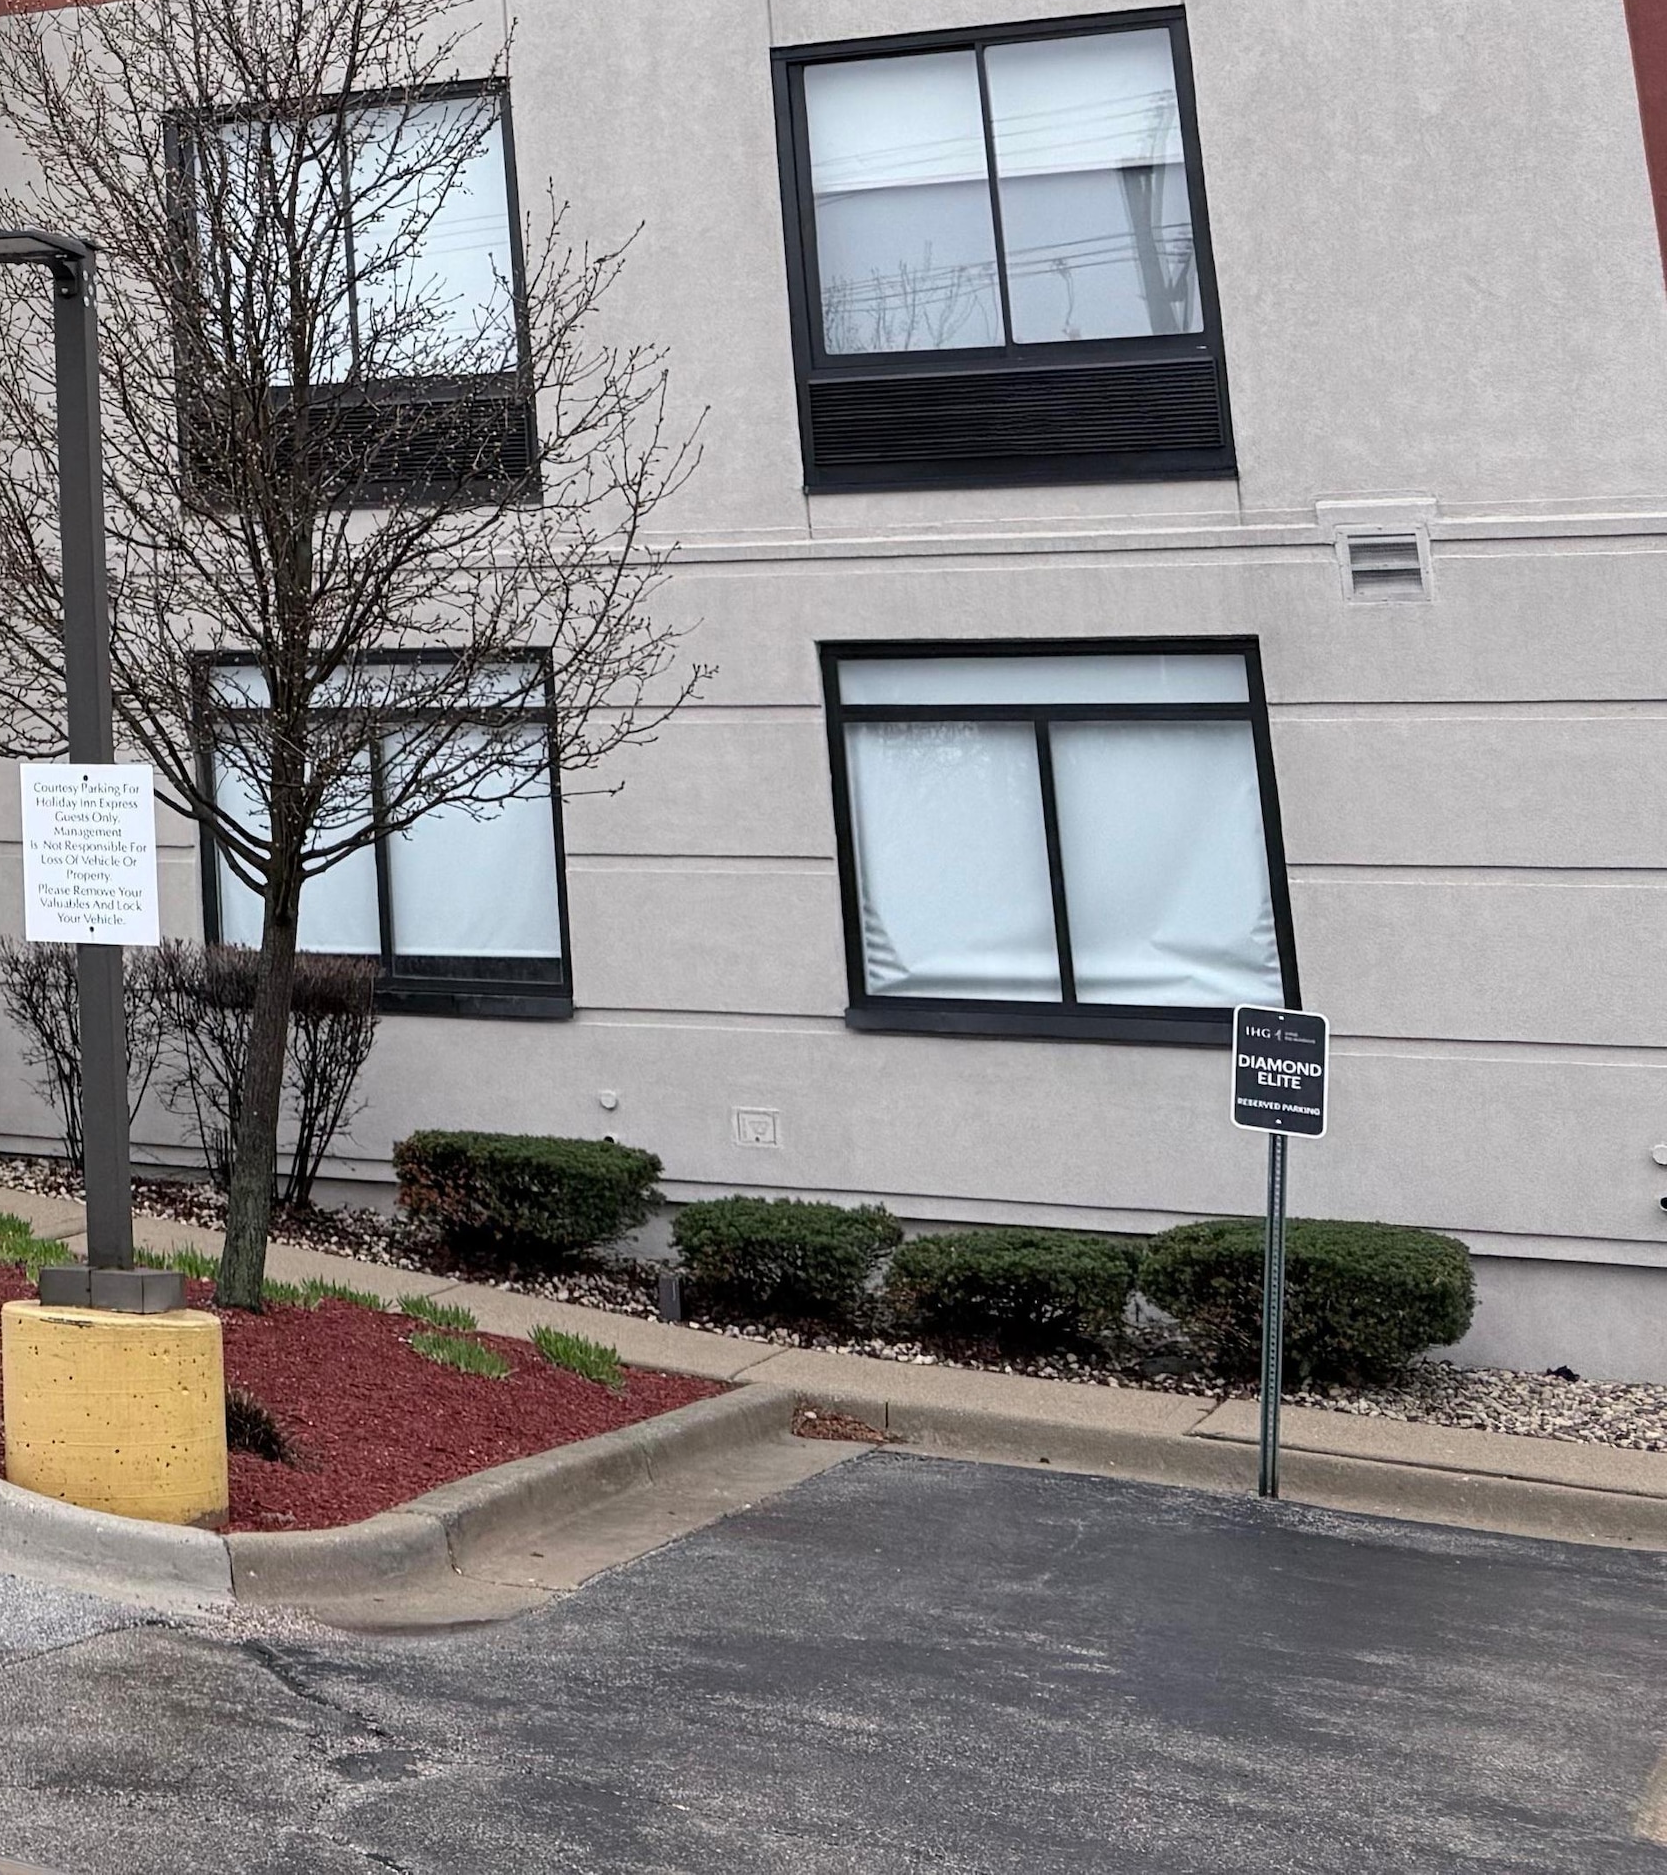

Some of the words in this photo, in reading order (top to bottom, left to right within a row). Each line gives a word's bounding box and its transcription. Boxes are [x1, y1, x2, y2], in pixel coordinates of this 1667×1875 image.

[33, 782, 78, 795] Courtesy
[81, 783, 121, 797] Parking
[123, 783, 140, 794] For
[36, 797, 77, 810] Holiday
[80, 798, 97, 808] Inn
[99, 798, 138, 810] Express
[54, 811, 89, 822] Guests
[92, 812, 121, 825] Only.
[54, 827, 122, 840] Management
[30, 840, 38, 850] Is
[43, 841, 62, 851] Not
[65, 840, 128, 853] Responsible
[130, 842, 147, 852] For
[41, 855, 63, 865] Loss
[65, 854, 78, 865] Of
[81, 855, 120, 866] Vehicle
[123, 856, 137, 867] Or
[38, 884, 70, 895] Please
[73, 885, 116, 896] Remove
[118, 887, 143, 898] Your
[40, 898, 90, 909] Valuables
[92, 900, 114, 910] And
[117, 901, 143, 911] Lock
[57, 913, 81, 923] Your
[1245, 1025, 1271, 1039] IHG
[1238, 1054, 1322, 1077] DIAMOND
[1257, 1071, 1302, 1090] ELITE
[1237, 1097, 1281, 1110] RESERVED
[1282, 1104, 1321, 1116] PARKING
